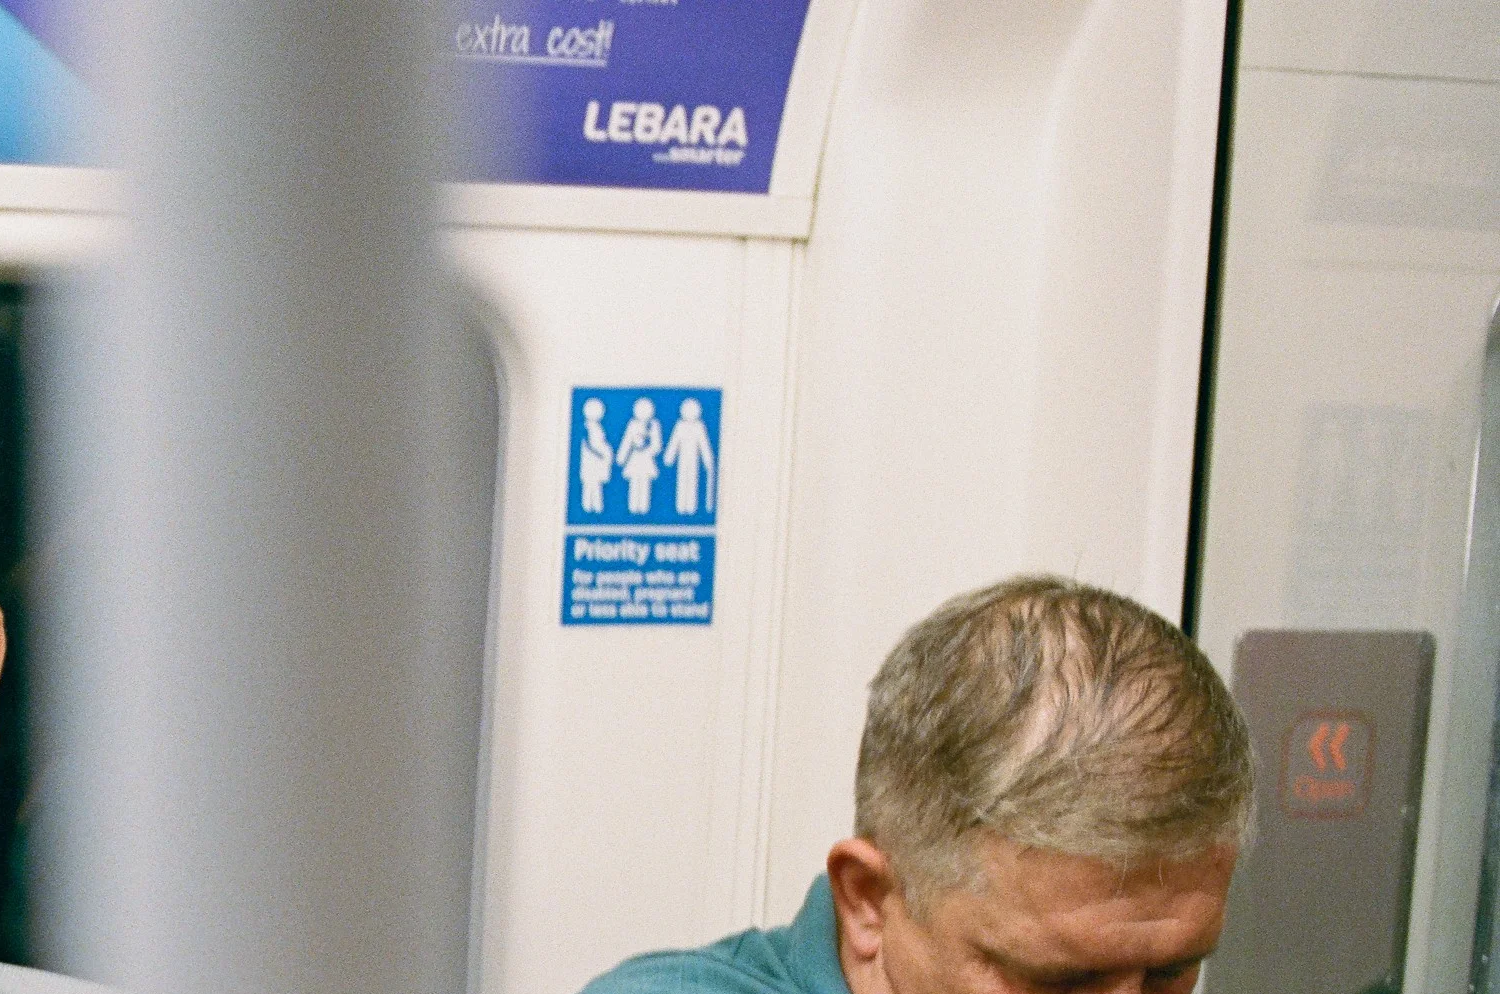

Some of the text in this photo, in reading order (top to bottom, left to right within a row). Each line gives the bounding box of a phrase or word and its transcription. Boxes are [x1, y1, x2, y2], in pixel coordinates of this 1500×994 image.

[456, 14, 532, 54] extra
[583, 100, 748, 147] LEBARA
[573, 538, 700, 566] Priority seat
